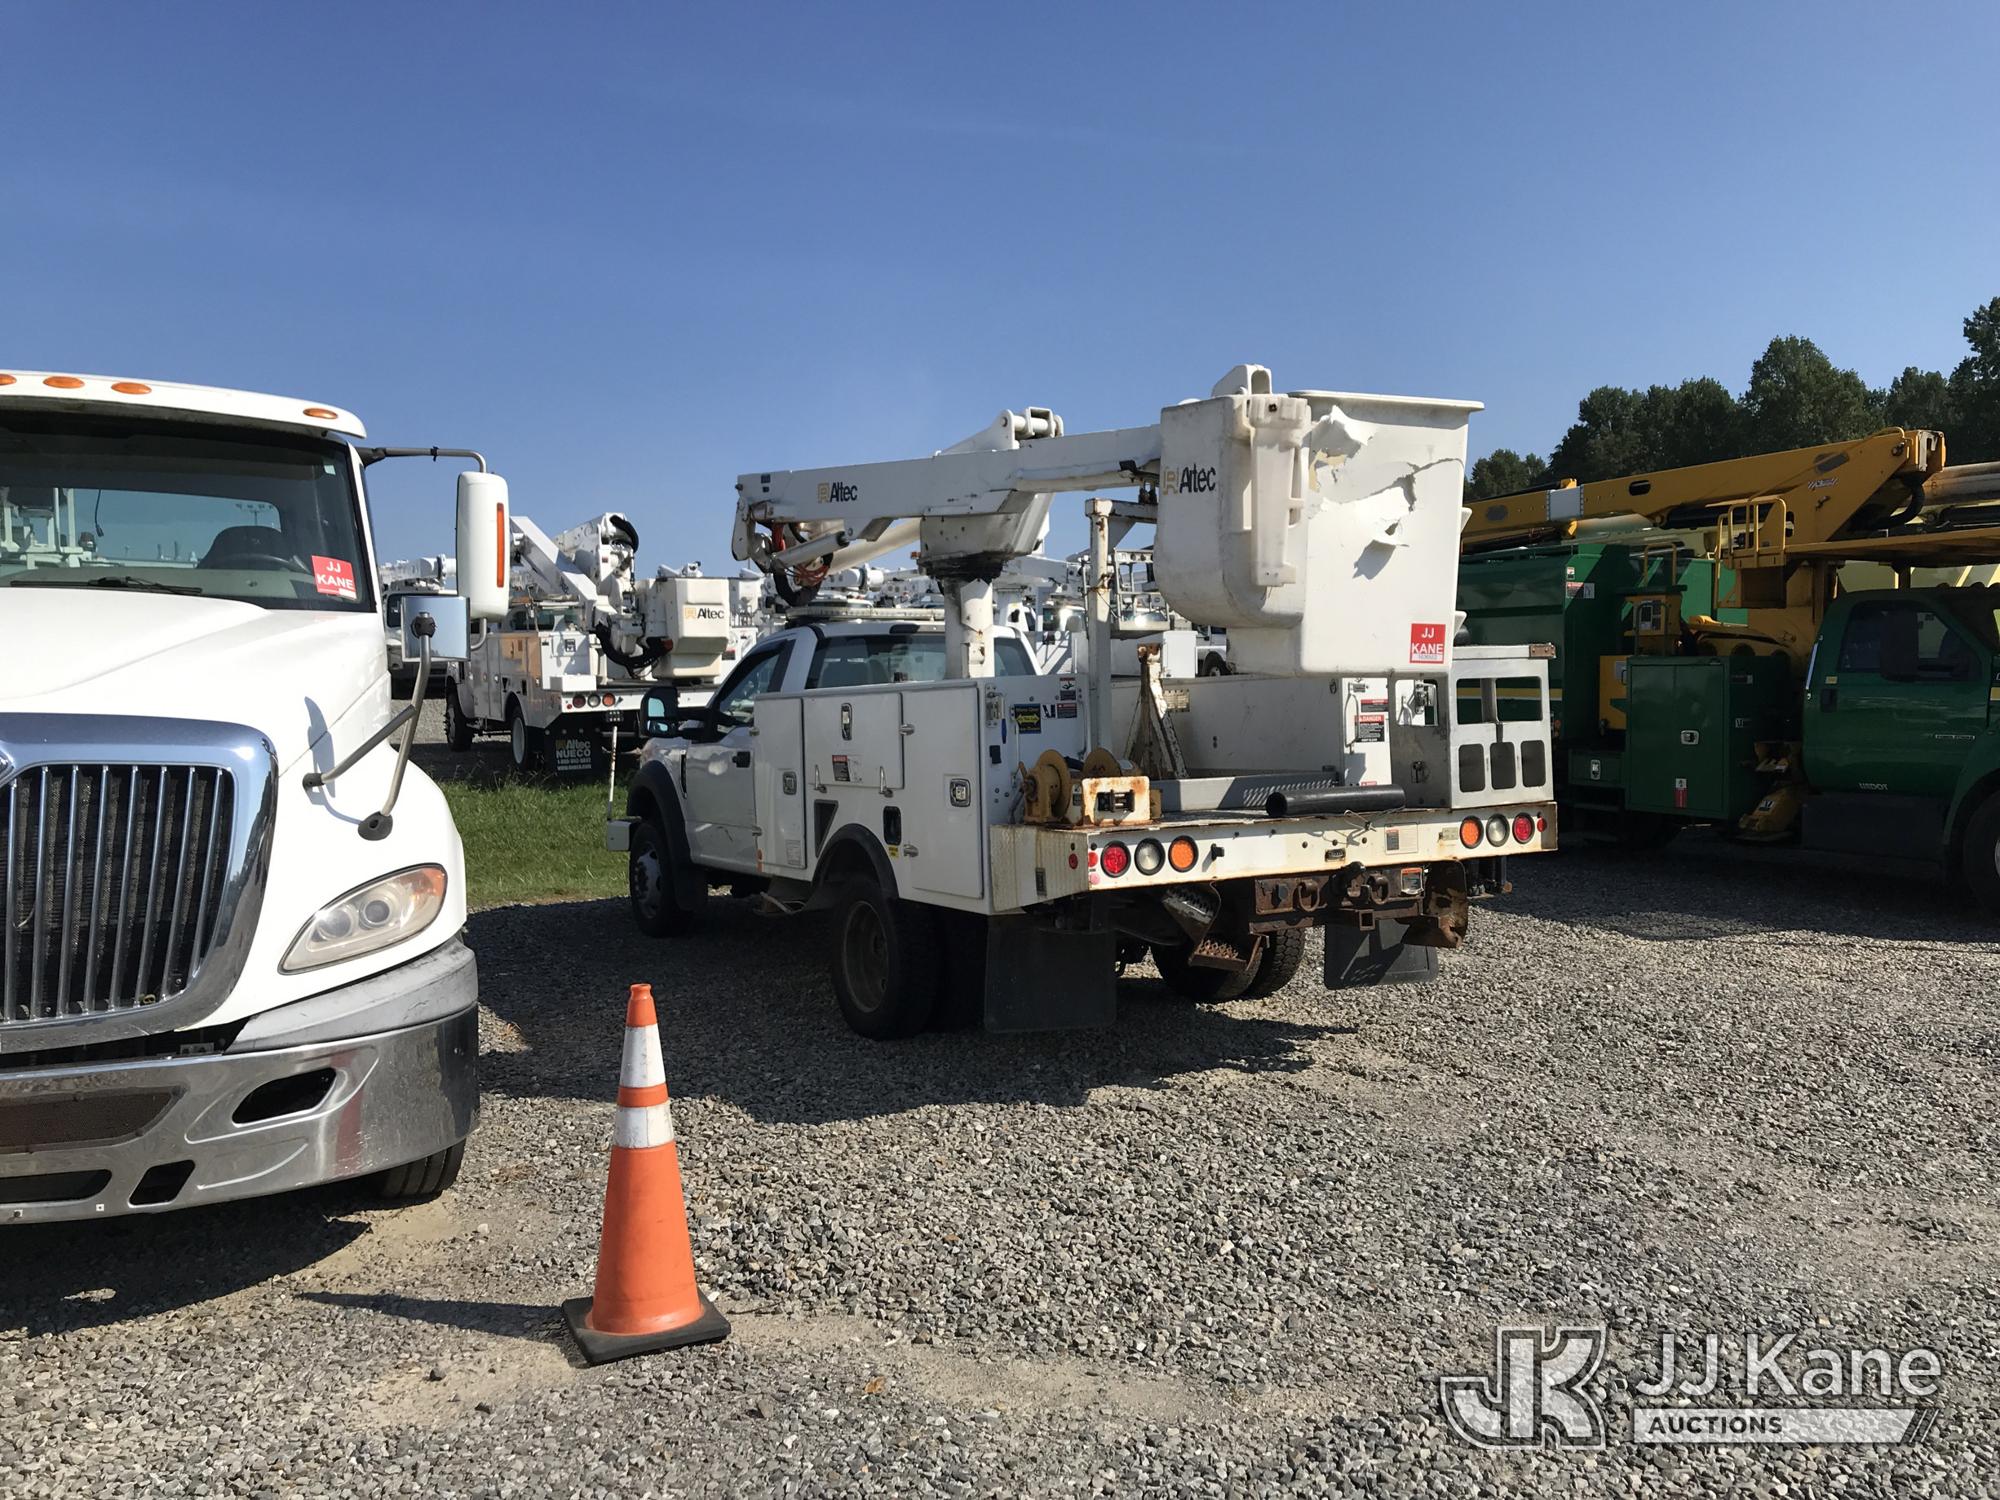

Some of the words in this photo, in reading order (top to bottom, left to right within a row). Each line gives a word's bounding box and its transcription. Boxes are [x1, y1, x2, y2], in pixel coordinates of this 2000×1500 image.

[1179, 463, 1217, 493] Altec
[829, 481, 858, 502] Altec
[326, 561, 342, 573] JJ
[316, 573, 355, 590] KANE
[697, 607, 725, 619] Altec
[1421, 627, 1435, 638] JJ
[1411, 643, 1444, 654] KANE
[566, 739, 591, 749] Altec
[556, 749, 591, 758] NUECO
